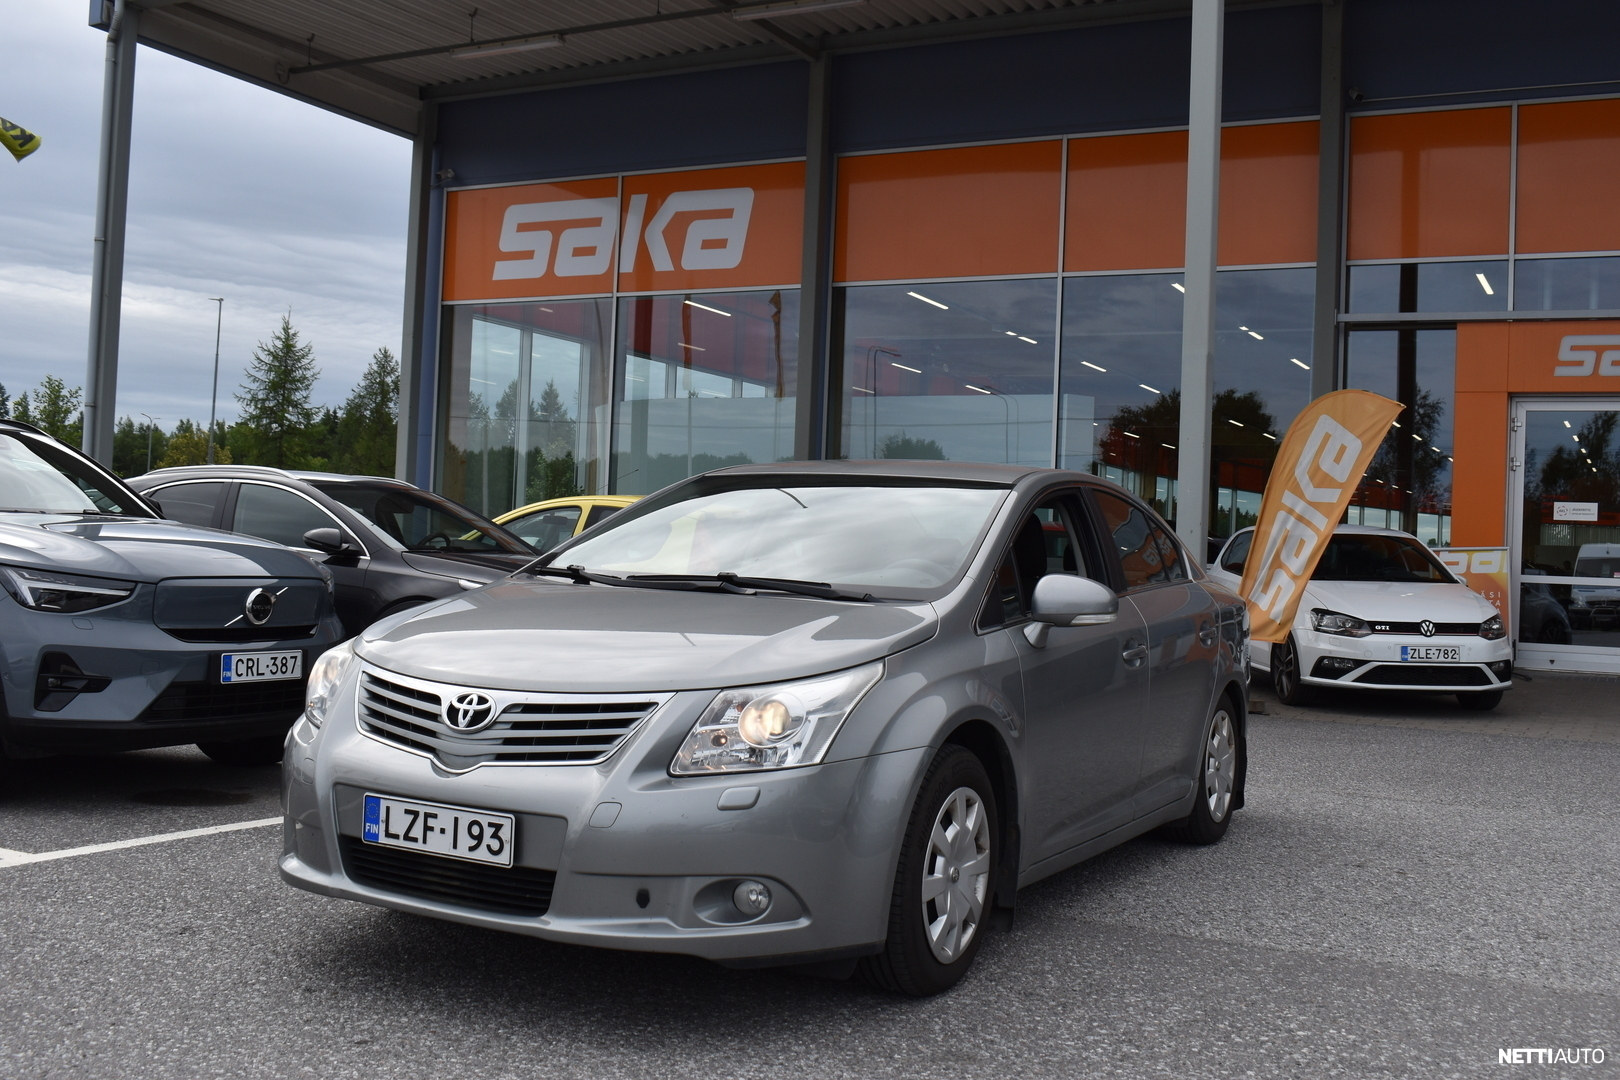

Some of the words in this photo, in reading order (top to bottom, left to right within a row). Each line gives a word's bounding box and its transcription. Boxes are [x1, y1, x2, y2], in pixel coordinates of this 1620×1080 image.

[1410, 648, 1457, 660] ZLE-782
[235, 656, 298, 677] CRL-387
[365, 822, 379, 835] FIN
[384, 805, 505, 856] LZF-193
